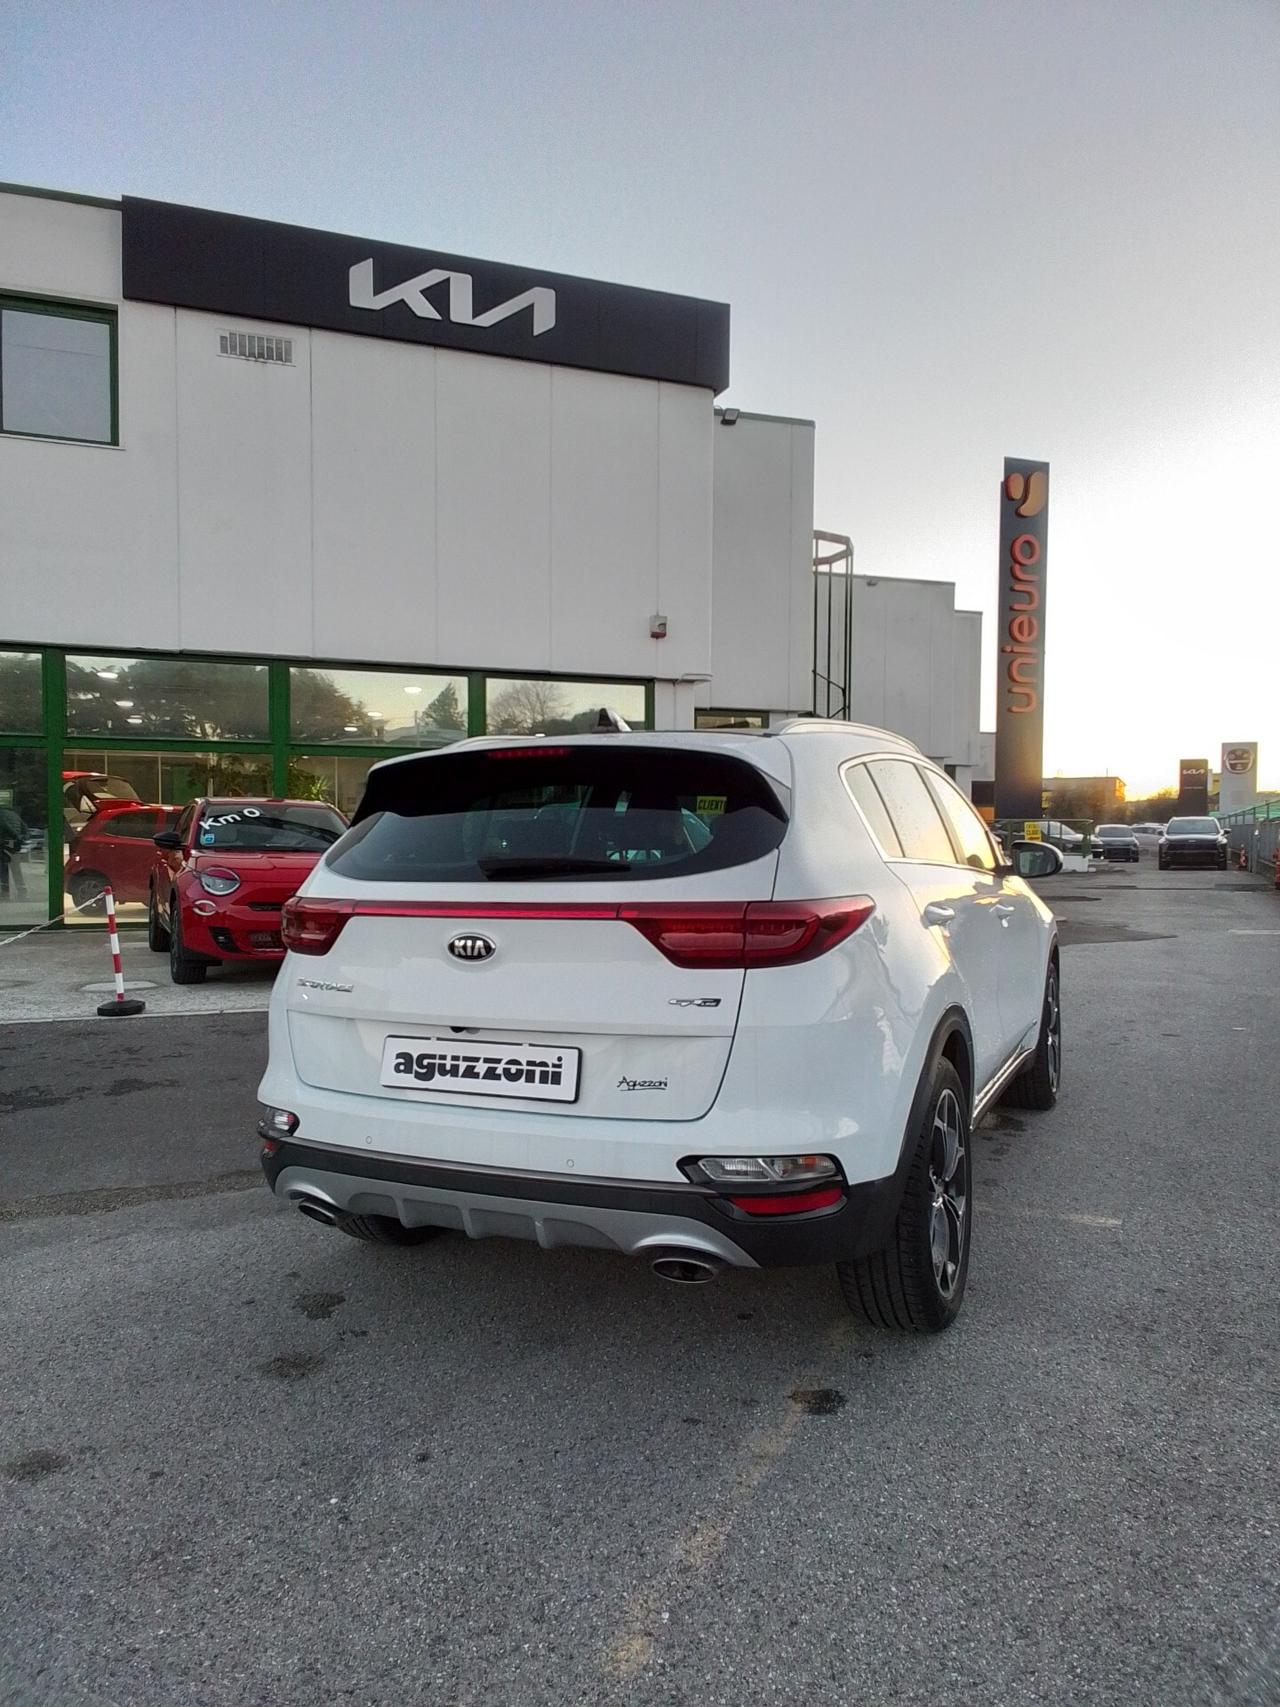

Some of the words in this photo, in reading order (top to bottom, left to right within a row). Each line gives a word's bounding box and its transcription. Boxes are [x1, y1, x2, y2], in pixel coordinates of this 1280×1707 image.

[349, 257, 556, 337] KIA
[1002, 534, 1040, 714] unieuro
[199, 813, 242, 830] Km
[242, 807, 261, 818] 0
[454, 939, 487, 956] KIA
[393, 1051, 563, 1086] aguzzoni
